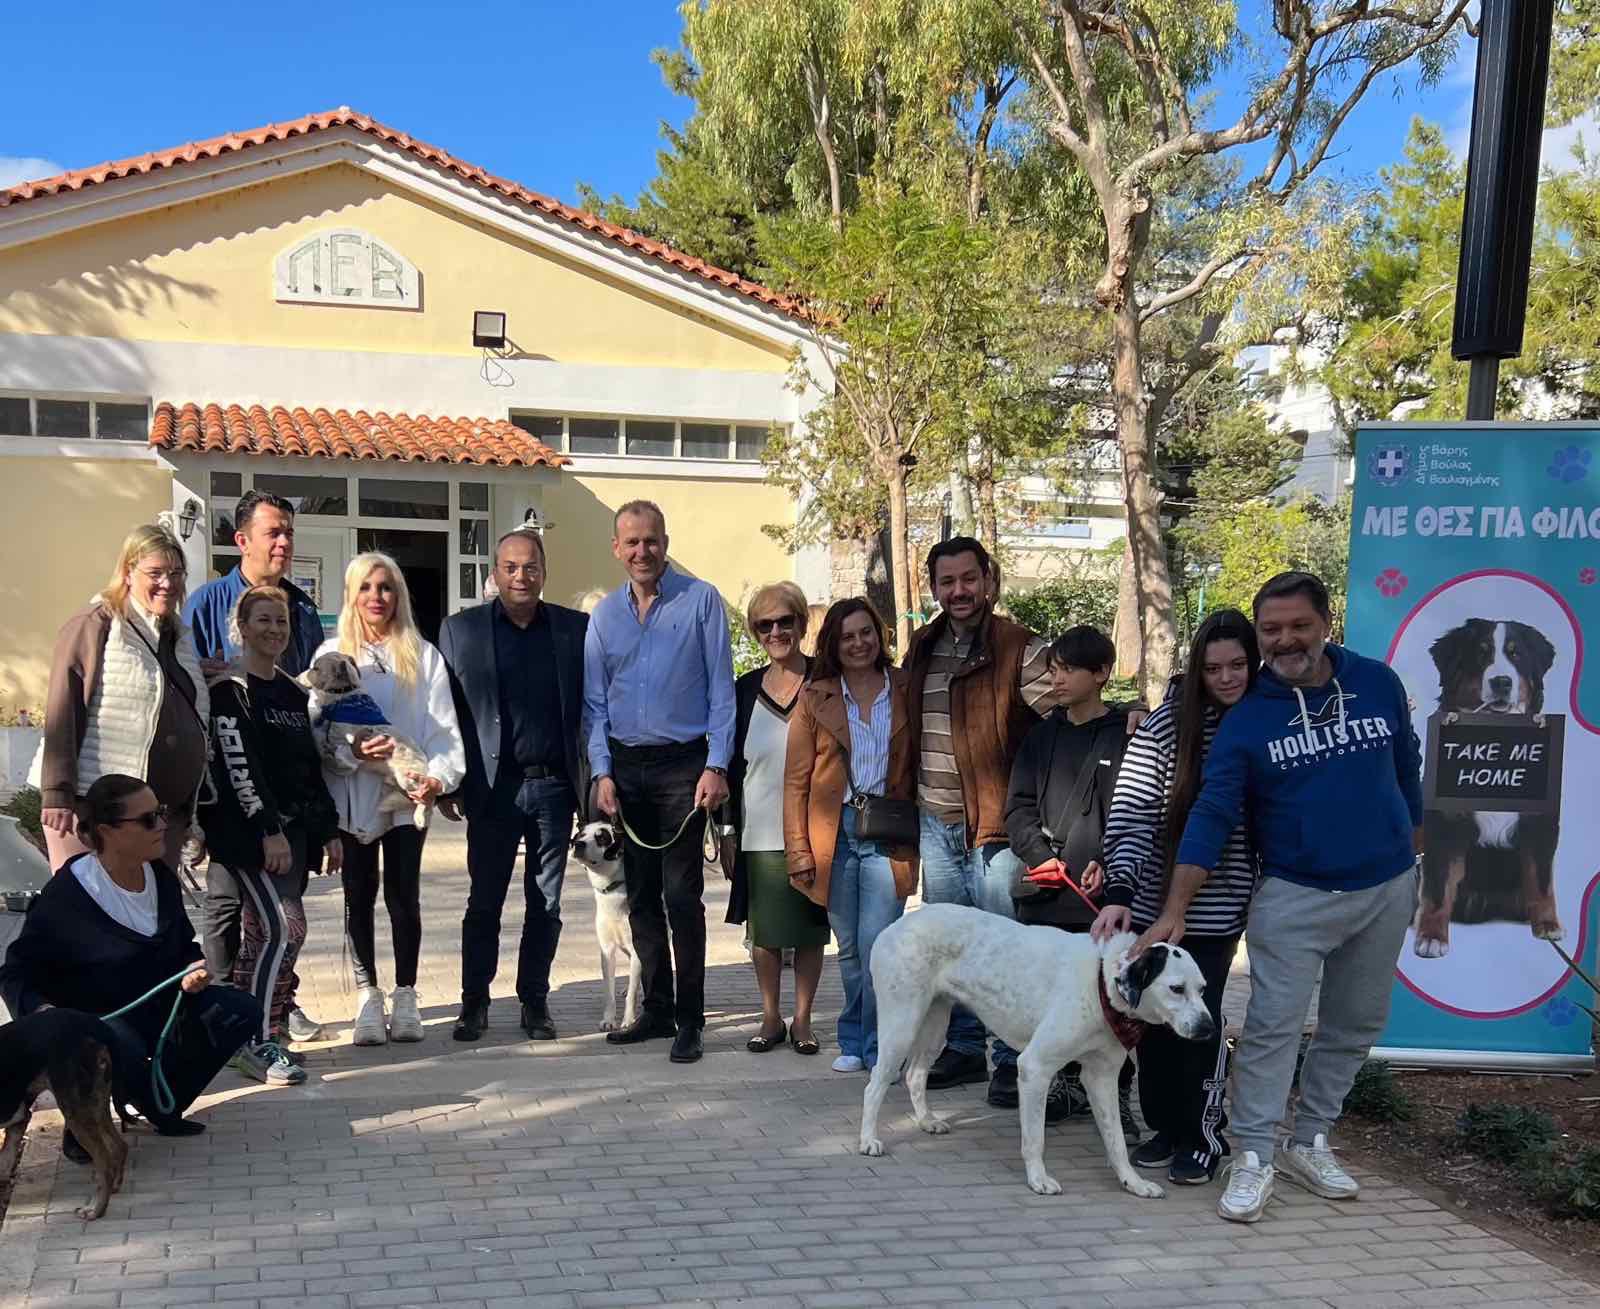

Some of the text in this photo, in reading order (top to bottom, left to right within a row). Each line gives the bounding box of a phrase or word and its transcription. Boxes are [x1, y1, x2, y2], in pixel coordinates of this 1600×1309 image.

[1430, 459, 1472, 472] Βούλας
[1361, 505, 1408, 538] ΜΕ
[1414, 505, 1475, 538] ΘΕΣ
[1479, 506, 1526, 539] ΓΙΑ
[1267, 716, 1393, 763] HOLLISTER
[1443, 742, 1544, 762] TAKE ME
[1280, 739, 1389, 771] CALIFORNIA
[1457, 768, 1526, 787] HOME
